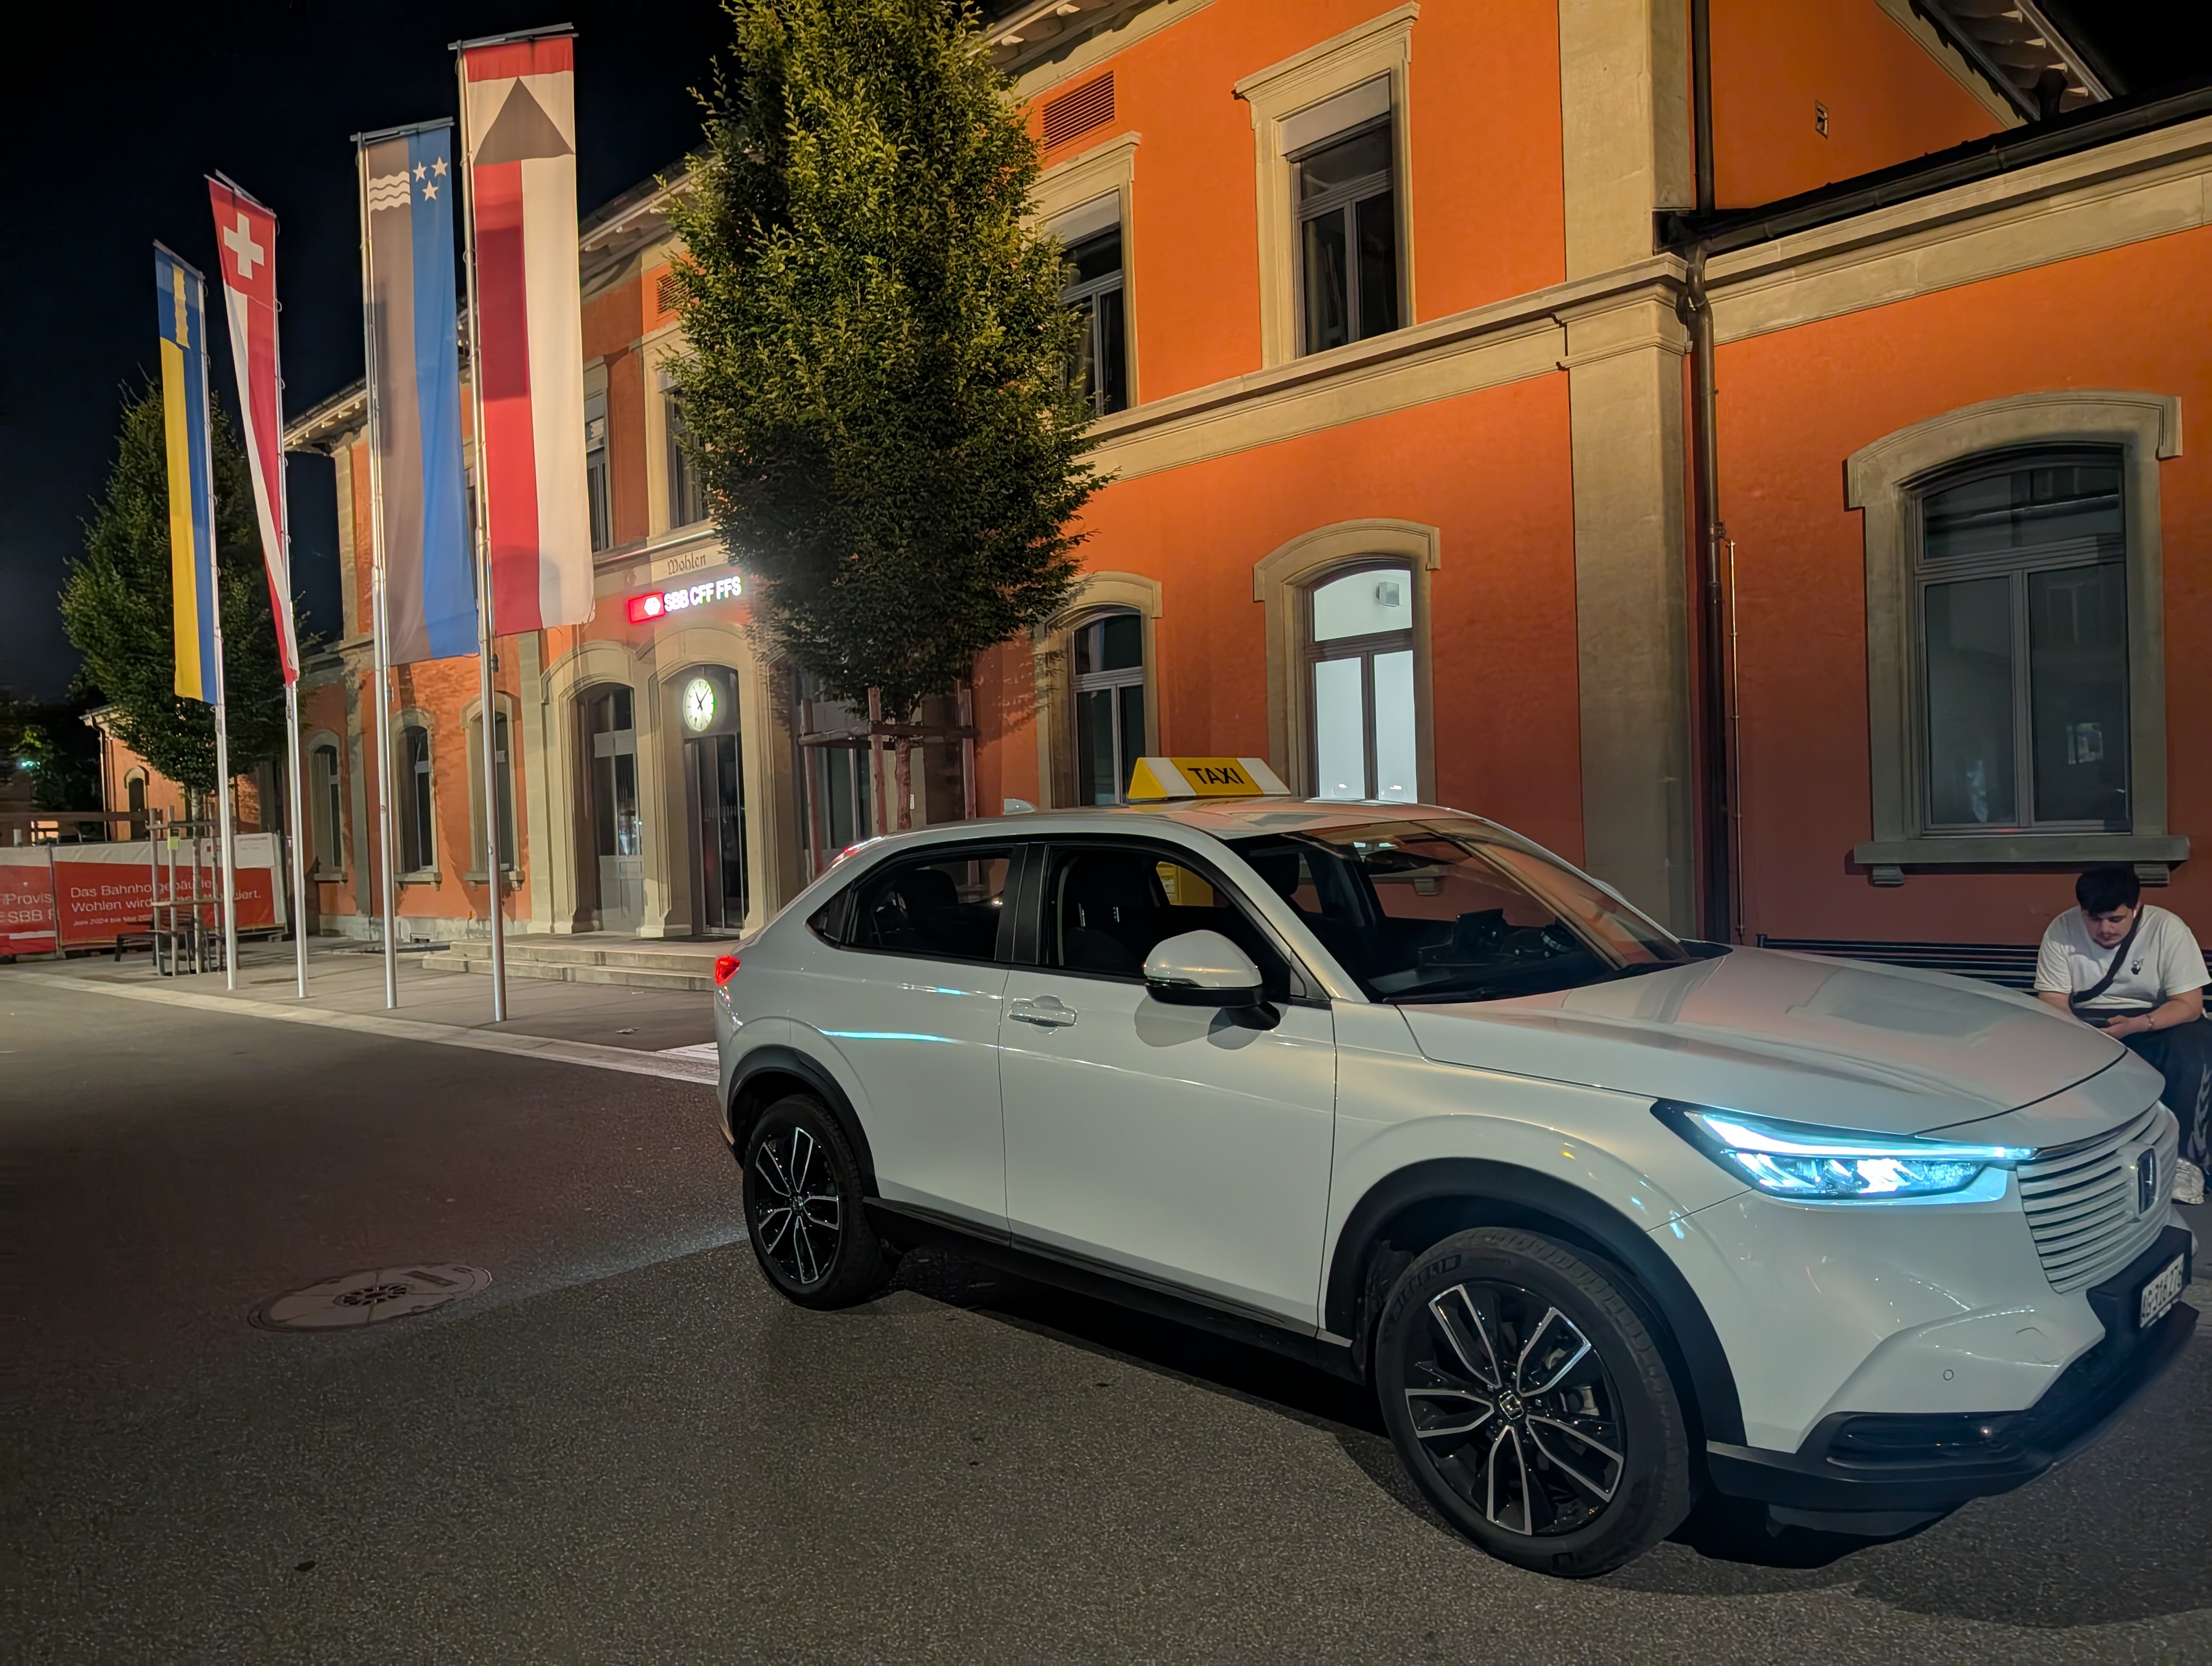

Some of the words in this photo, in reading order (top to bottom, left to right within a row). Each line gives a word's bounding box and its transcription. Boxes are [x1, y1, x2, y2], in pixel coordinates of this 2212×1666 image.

[667, 553, 706, 575] Wohlen
[664, 589, 690, 612] SBB
[690, 582, 714, 606] CFF
[716, 576, 742, 600] FFS
[1187, 767, 1245, 784] TAXI
[70, 887, 97, 898] Das
[72, 900, 121, 912] Wohlen
[125, 898, 152, 909] wird
[8, 909, 43, 923] SBB
